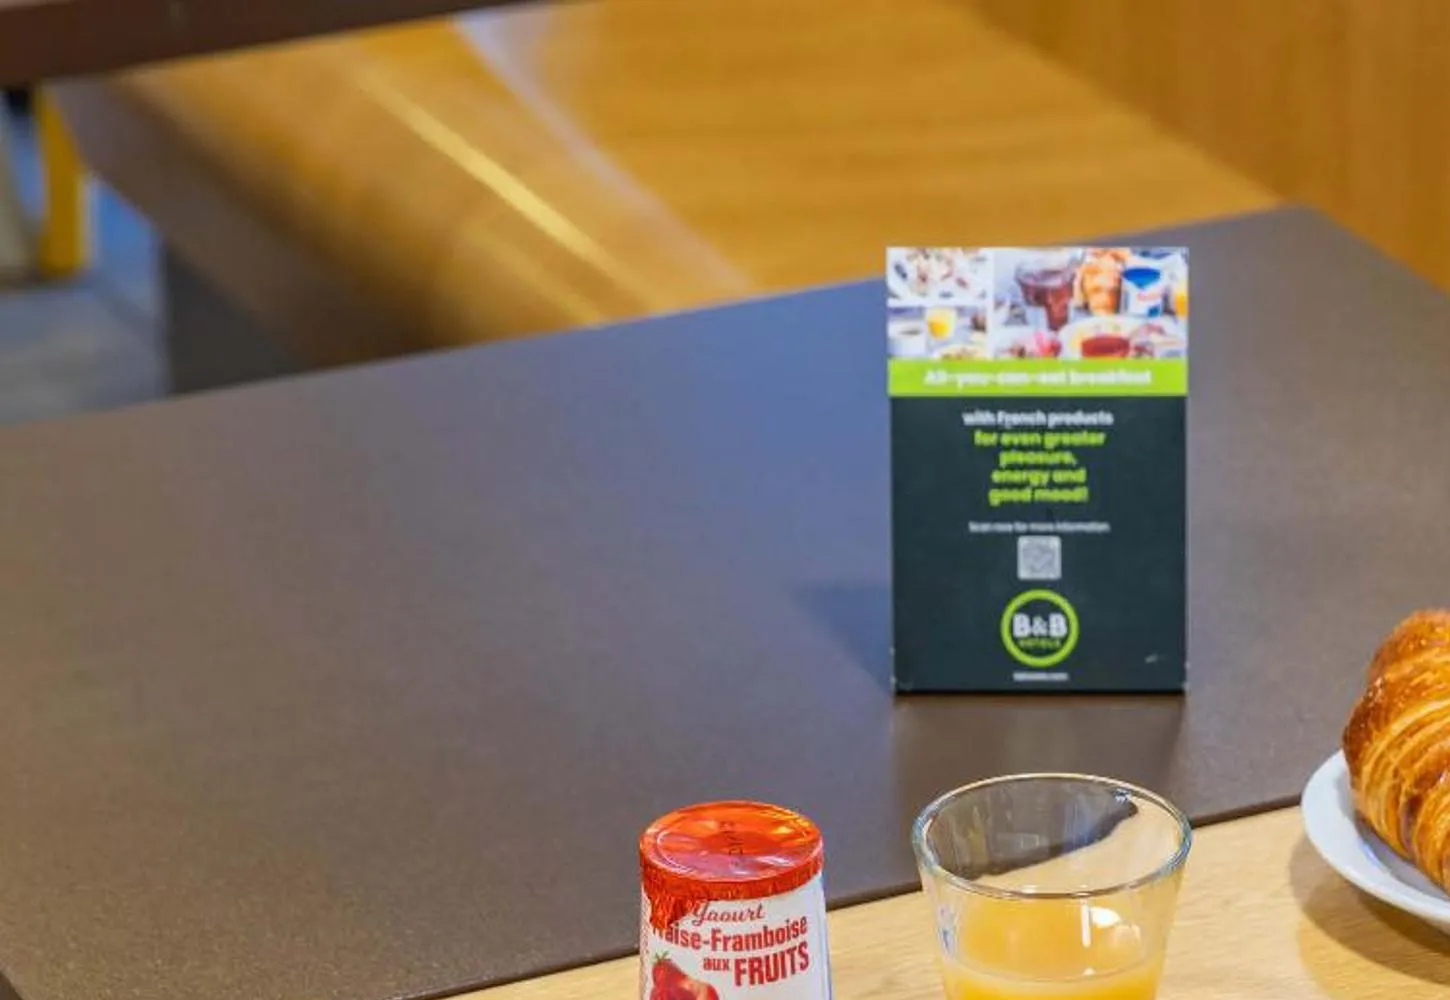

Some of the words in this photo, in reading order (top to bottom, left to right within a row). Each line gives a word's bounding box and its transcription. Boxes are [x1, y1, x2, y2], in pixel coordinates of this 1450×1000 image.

[1067, 369, 1151, 386] breakfast
[962, 410, 995, 426] with
[997, 409, 1046, 430] French
[1047, 410, 1114, 429] products
[974, 430, 998, 446] for
[1000, 432, 1041, 446] even
[1043, 430, 1106, 449] greater
[991, 469, 1049, 487] energy
[1052, 467, 1086, 483] and
[988, 486, 1031, 506] good
[1013, 612, 1067, 637] B&B
[703, 957, 729, 971] aux
[734, 941, 809, 986] FRUITS
